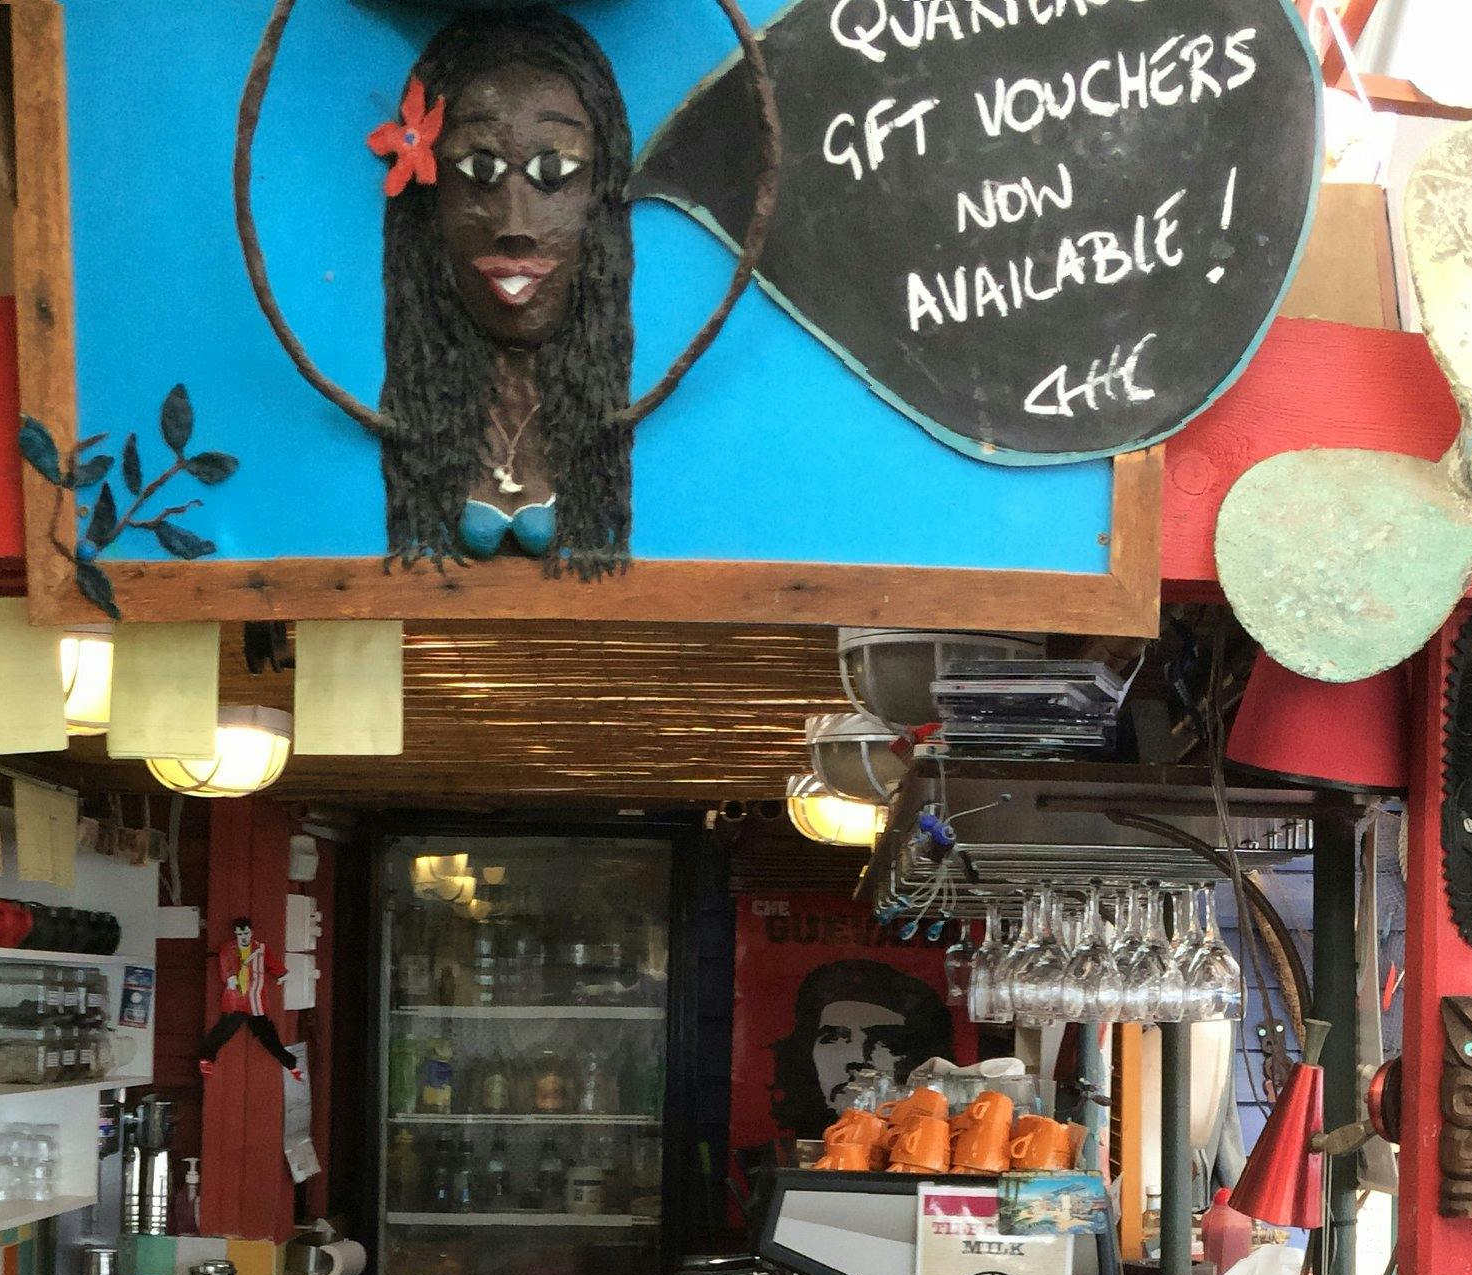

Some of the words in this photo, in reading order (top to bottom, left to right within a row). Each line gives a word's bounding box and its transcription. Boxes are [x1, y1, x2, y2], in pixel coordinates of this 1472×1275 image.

[975, 26, 1258, 138] VOUCHERS
[956, 163, 1075, 233] NOW
[906, 188, 1187, 333] AVAILABLE
[961, 1239, 1026, 1256] MILK
